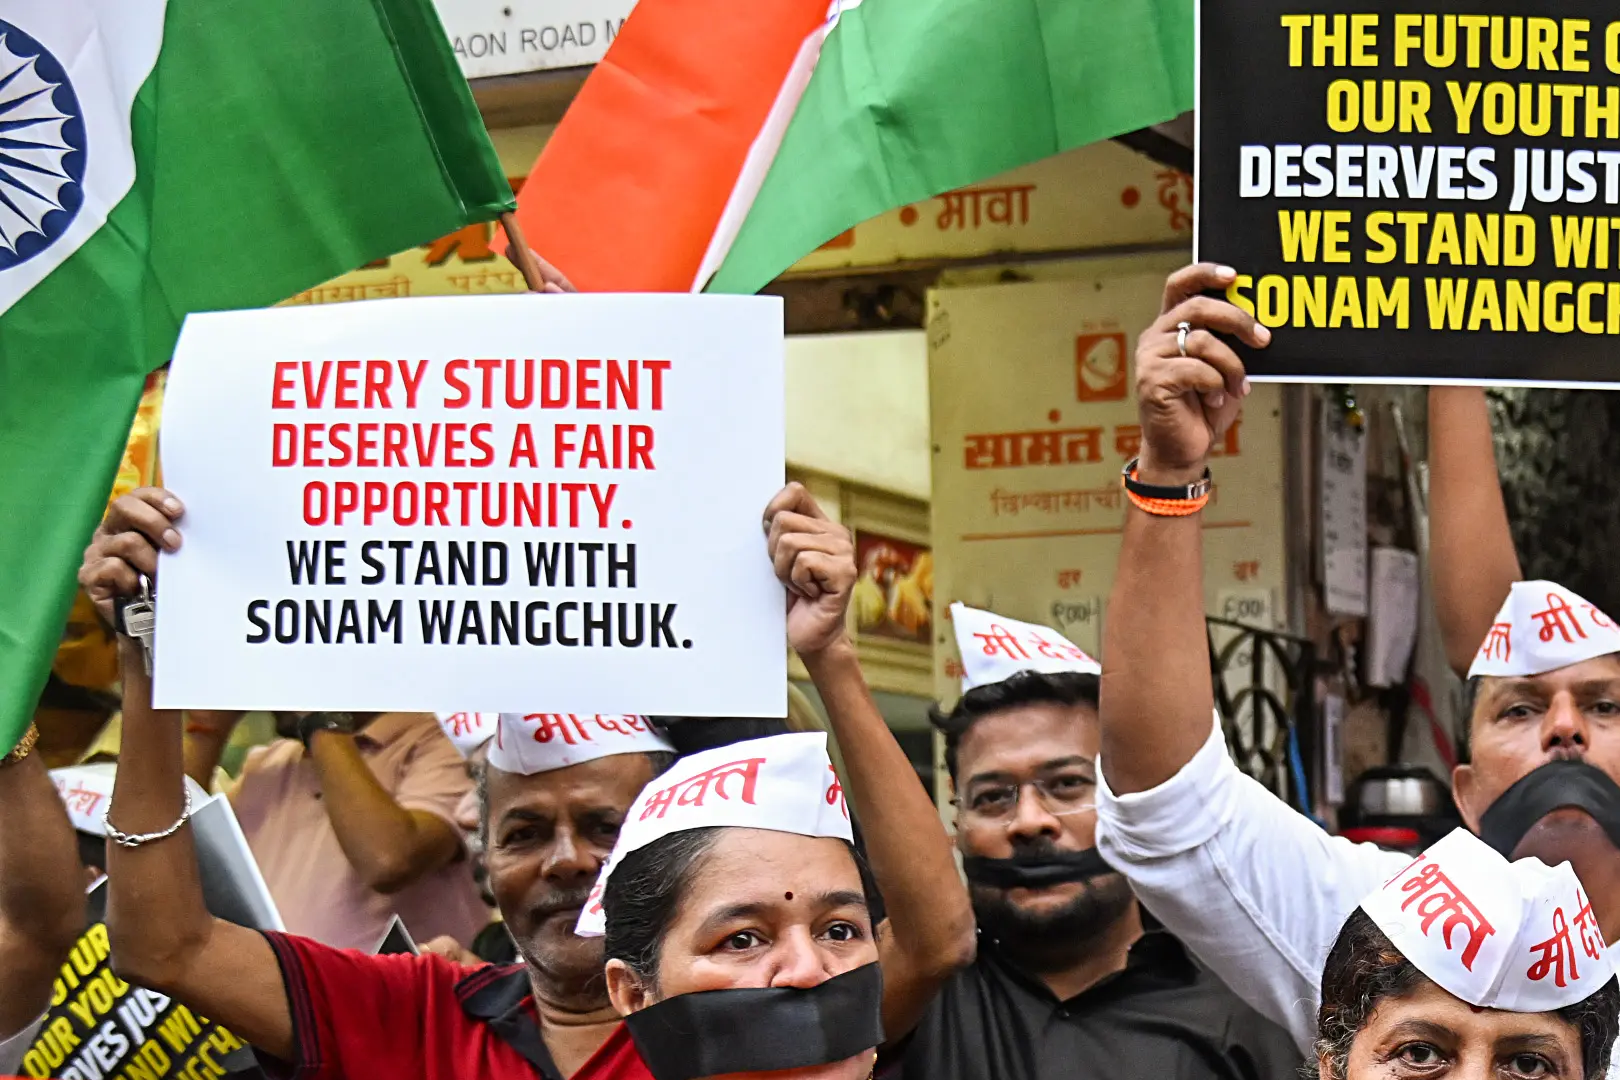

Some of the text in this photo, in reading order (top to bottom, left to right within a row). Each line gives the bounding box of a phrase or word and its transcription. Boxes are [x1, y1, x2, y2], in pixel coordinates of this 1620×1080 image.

[454, 32, 507, 59] AON
[521, 22, 596, 53] ROAD
[1281, 14, 1378, 66] THE
[1395, 14, 1590, 72] FUTURE
[1327, 79, 1619, 138] OUR YOUTH
[1240, 145, 1497, 200] DESERVES
[935, 184, 1036, 232] मावा
[1278, 210, 1351, 262] WE
[1366, 211, 1535, 266] STAND
[1226, 275, 1409, 329] SONAM
[272, 359, 671, 410] EVERY STUDENT
[273, 423, 655, 469] DESERVES A FAIR
[965, 410, 1104, 470] सामंत
[304, 481, 632, 529] OPPORTUNITY.
[287, 541, 635, 587] WE STAND WITH
[247, 600, 691, 648] SONAM WANGCHUK.
[973, 624, 1033, 661] मी
[1531, 592, 1589, 643] मी
[639, 757, 767, 823] भक्त
[1401, 863, 1496, 973] भक्त
[1527, 907, 1581, 988] मी
[23, 1016, 81, 1080] OUR
